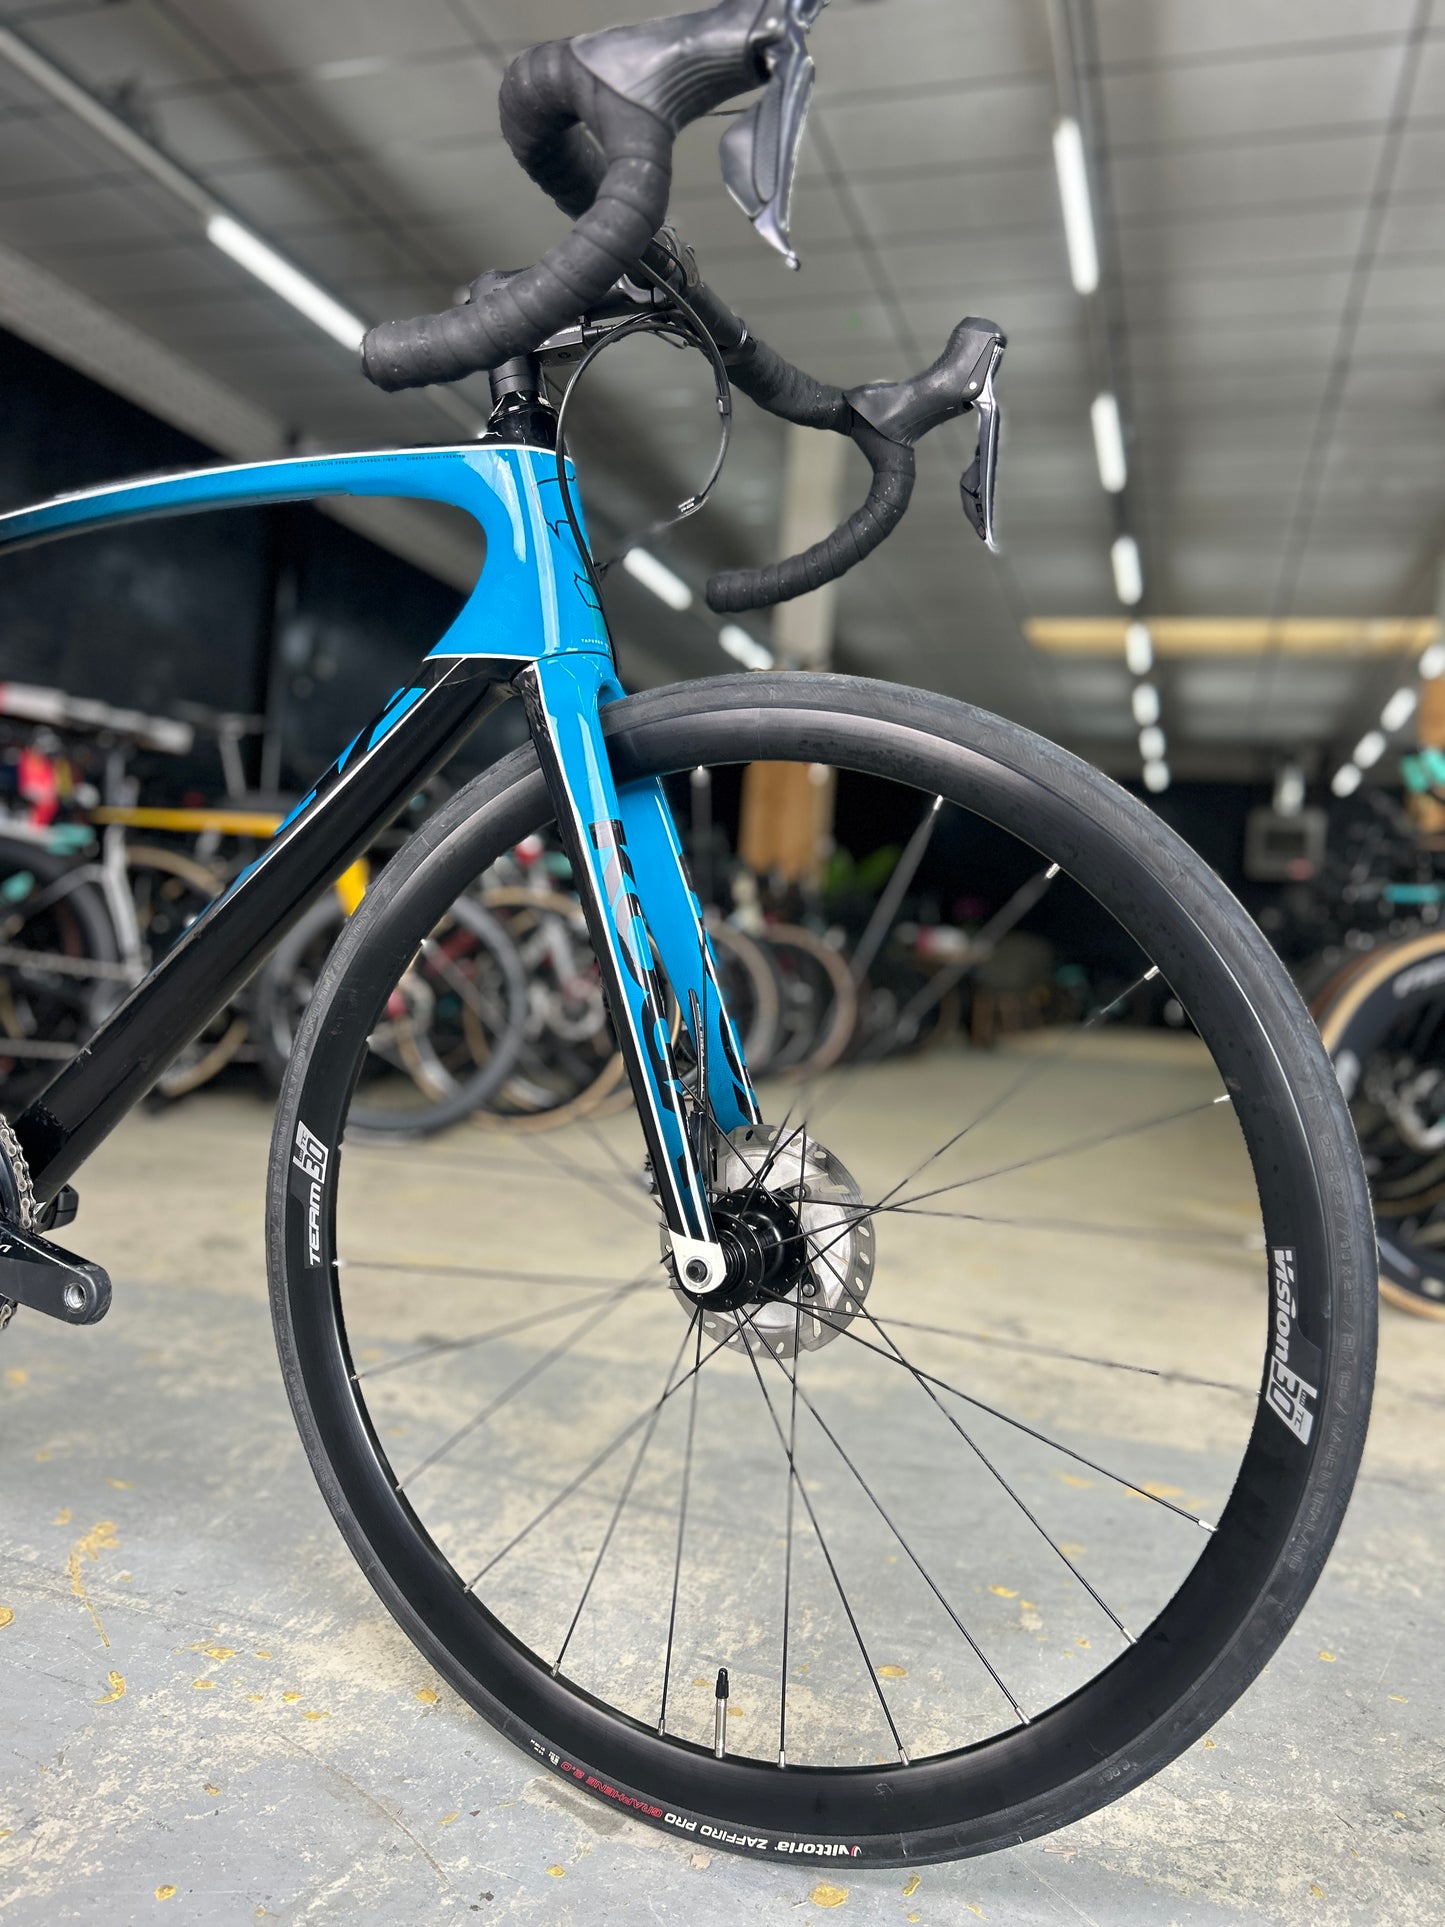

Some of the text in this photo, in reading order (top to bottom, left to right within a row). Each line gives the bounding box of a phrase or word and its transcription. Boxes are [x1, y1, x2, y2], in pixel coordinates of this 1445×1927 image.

[303, 1137, 326, 1266] TEAM 30
[1269, 1249, 1300, 1421] Vision 30
[560, 1761, 850, 1857] vittoria ZAFFIRO PRO GRAPHENE 2.0
